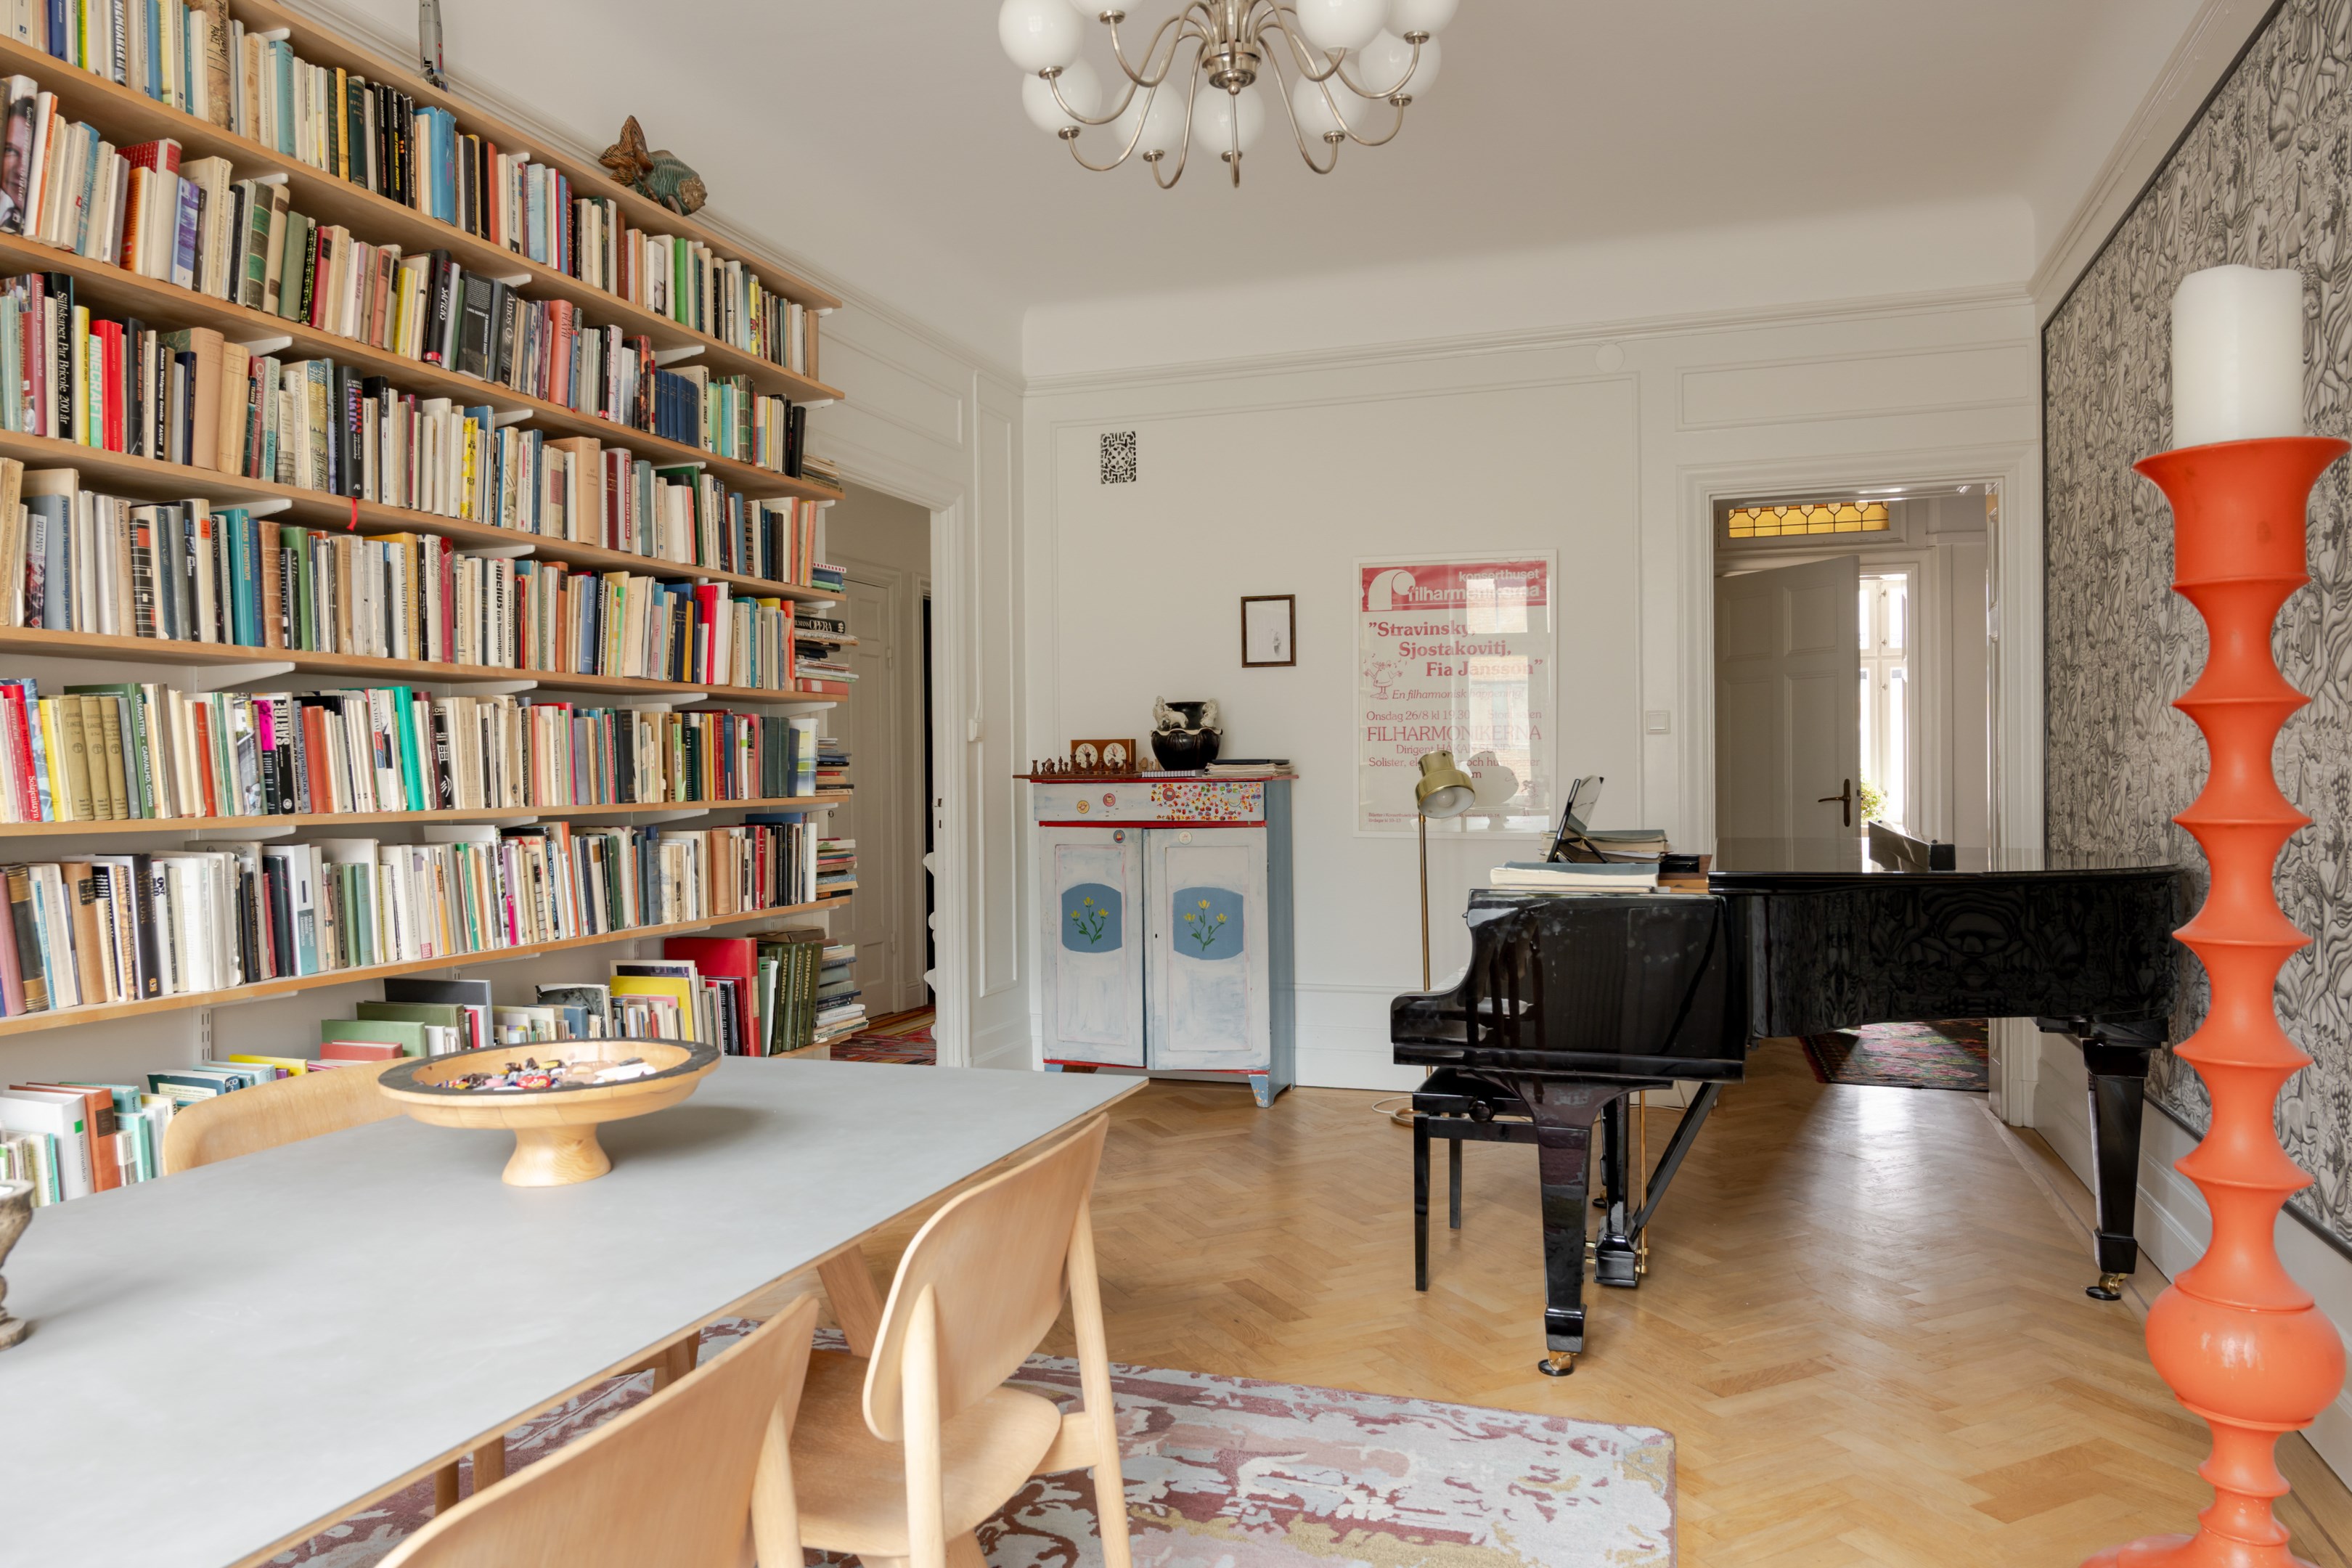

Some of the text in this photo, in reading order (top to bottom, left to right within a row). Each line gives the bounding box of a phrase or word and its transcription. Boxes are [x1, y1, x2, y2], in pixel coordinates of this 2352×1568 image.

[115, 0, 125, 60] MEMOARER
[210, 25, 221, 46] PAKET
[440, 287, 450, 320] SAPIENS
[505, 292, 516, 345] Amos Oz
[57, 291, 70, 424] Sällskapet Par Bricole 200 år
[89, 335, 103, 421] MINECRAFT
[255, 363, 265, 413] OSCAR WILDE
[269, 398, 276, 409] AV
[318, 384, 327, 418] Svenska
[36, 521, 44, 552] BELLMAN
[62, 570, 70, 599] oändliga
[1458, 568, 1540, 581] konserthuset
[809, 618, 833, 632] OPERA
[1425, 661, 1453, 677] Fia
[371, 693, 381, 732] STENDHAL
[1392, 690, 1405, 699] En
[1405, 689, 1466, 703] filharmonisk
[10, 706, 19, 740] NIETZSCHE
[136, 693, 145, 737] VASAKATTEN
[274, 703, 290, 745] SARTRE
[1366, 711, 1403, 722] Onsdag
[1405, 710, 1429, 720] 26/8
[1431, 710, 1440, 720] kl
[1367, 726, 1542, 741] FILHARMONIKERNA
[1396, 744, 1434, 756] Dirigent
[23, 729, 32, 767] Medvedev
[28, 775, 40, 819] Solzjenitzyn
[298, 746, 309, 796] uppslagsbok
[1368, 757, 1406, 767] Solister,
[139, 870, 151, 924] Min röst
[79, 1135, 88, 1183] Internmedicin
